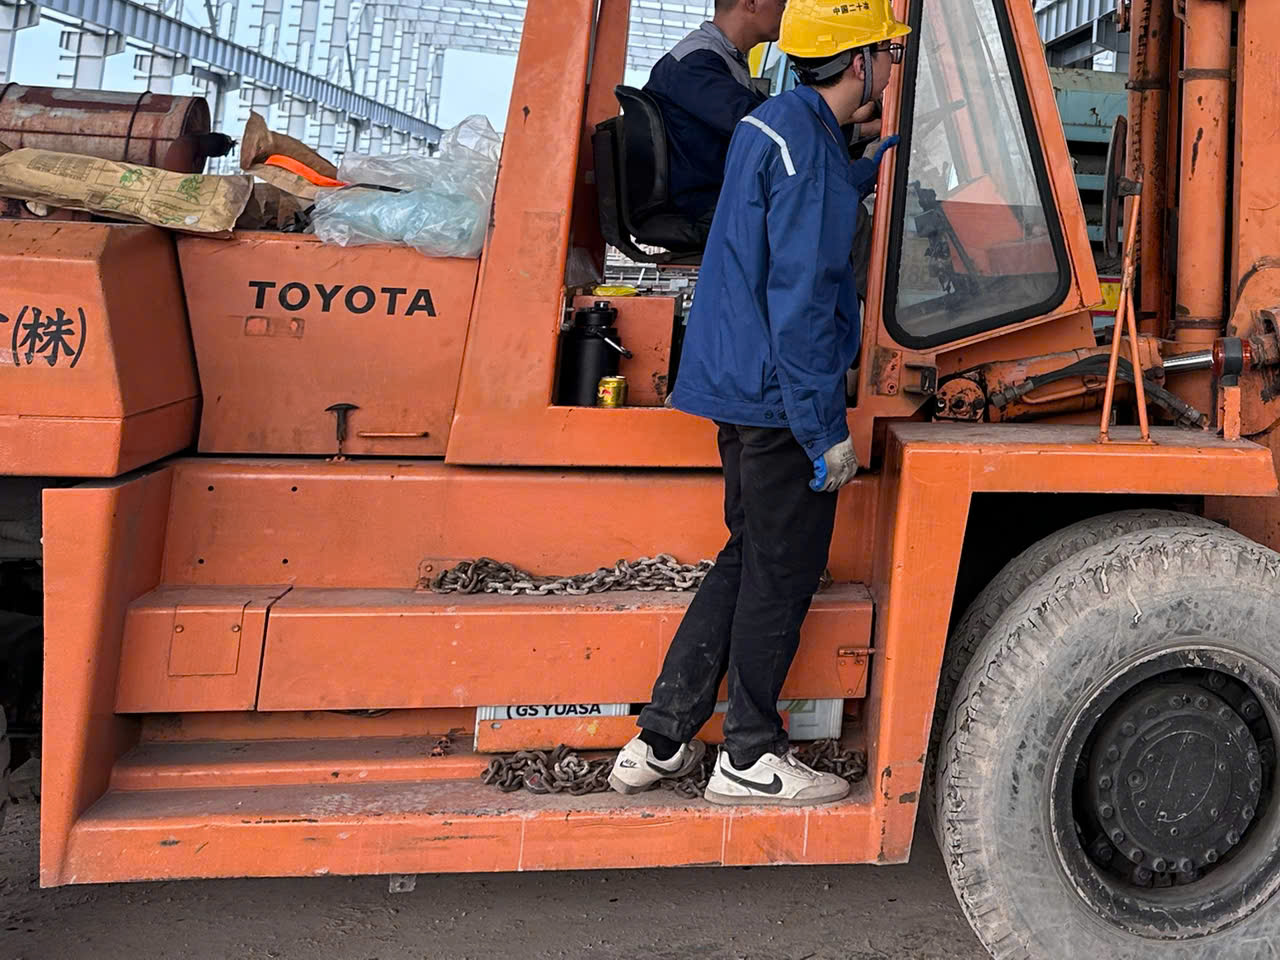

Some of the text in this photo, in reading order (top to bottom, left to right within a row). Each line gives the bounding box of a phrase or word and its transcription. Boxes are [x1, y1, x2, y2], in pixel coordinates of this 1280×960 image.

[248, 281, 437, 317] TOYOTA
[0, 304, 87, 369] (株)
[516, 703, 601, 717] GS YUASA
